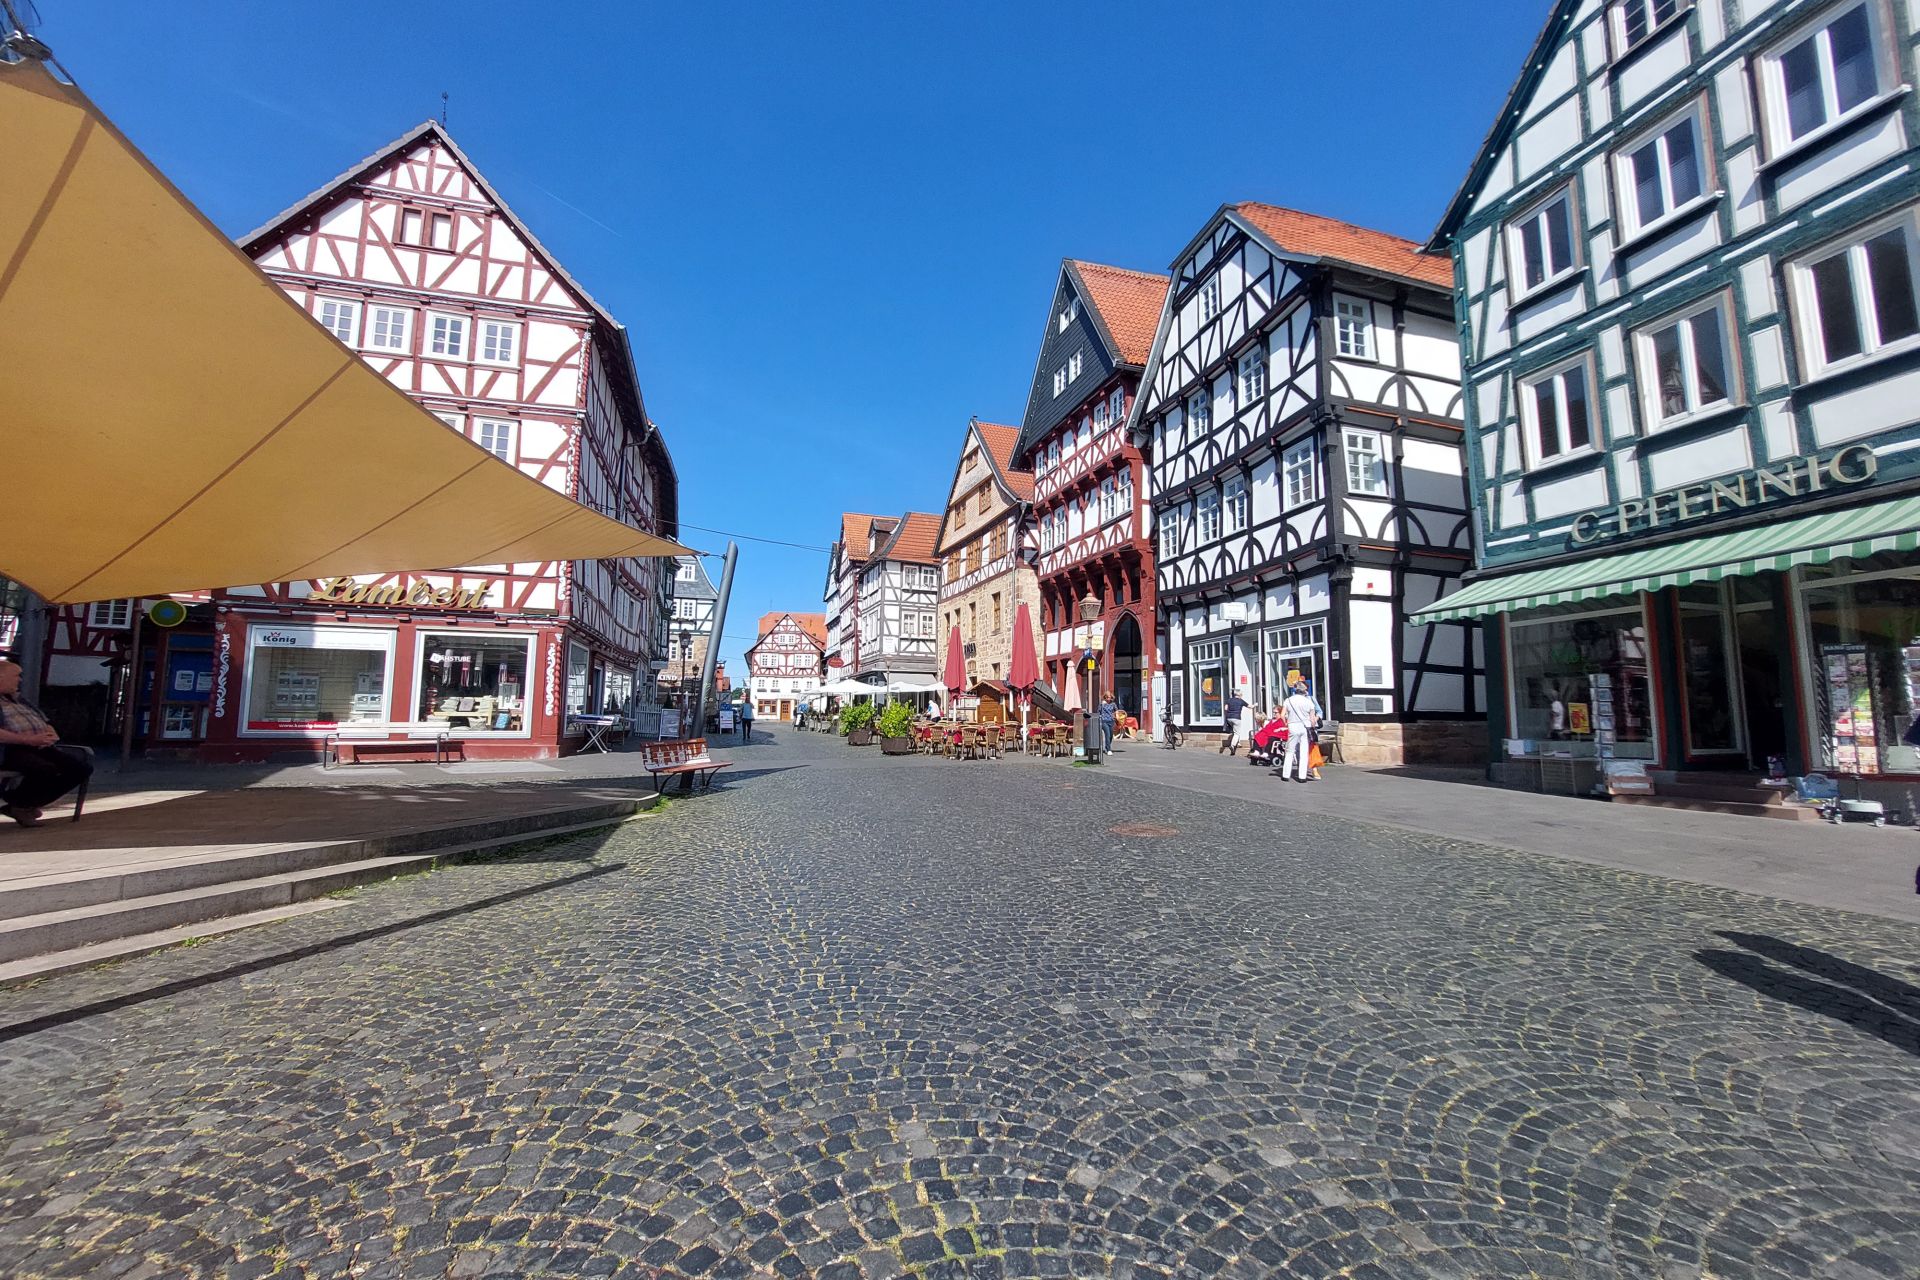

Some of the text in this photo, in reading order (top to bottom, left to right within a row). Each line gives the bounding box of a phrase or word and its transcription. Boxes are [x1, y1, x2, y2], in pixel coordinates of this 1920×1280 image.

[1570, 443, 1878, 544] C. PFENNIG
[307, 575, 490, 608] Lambert
